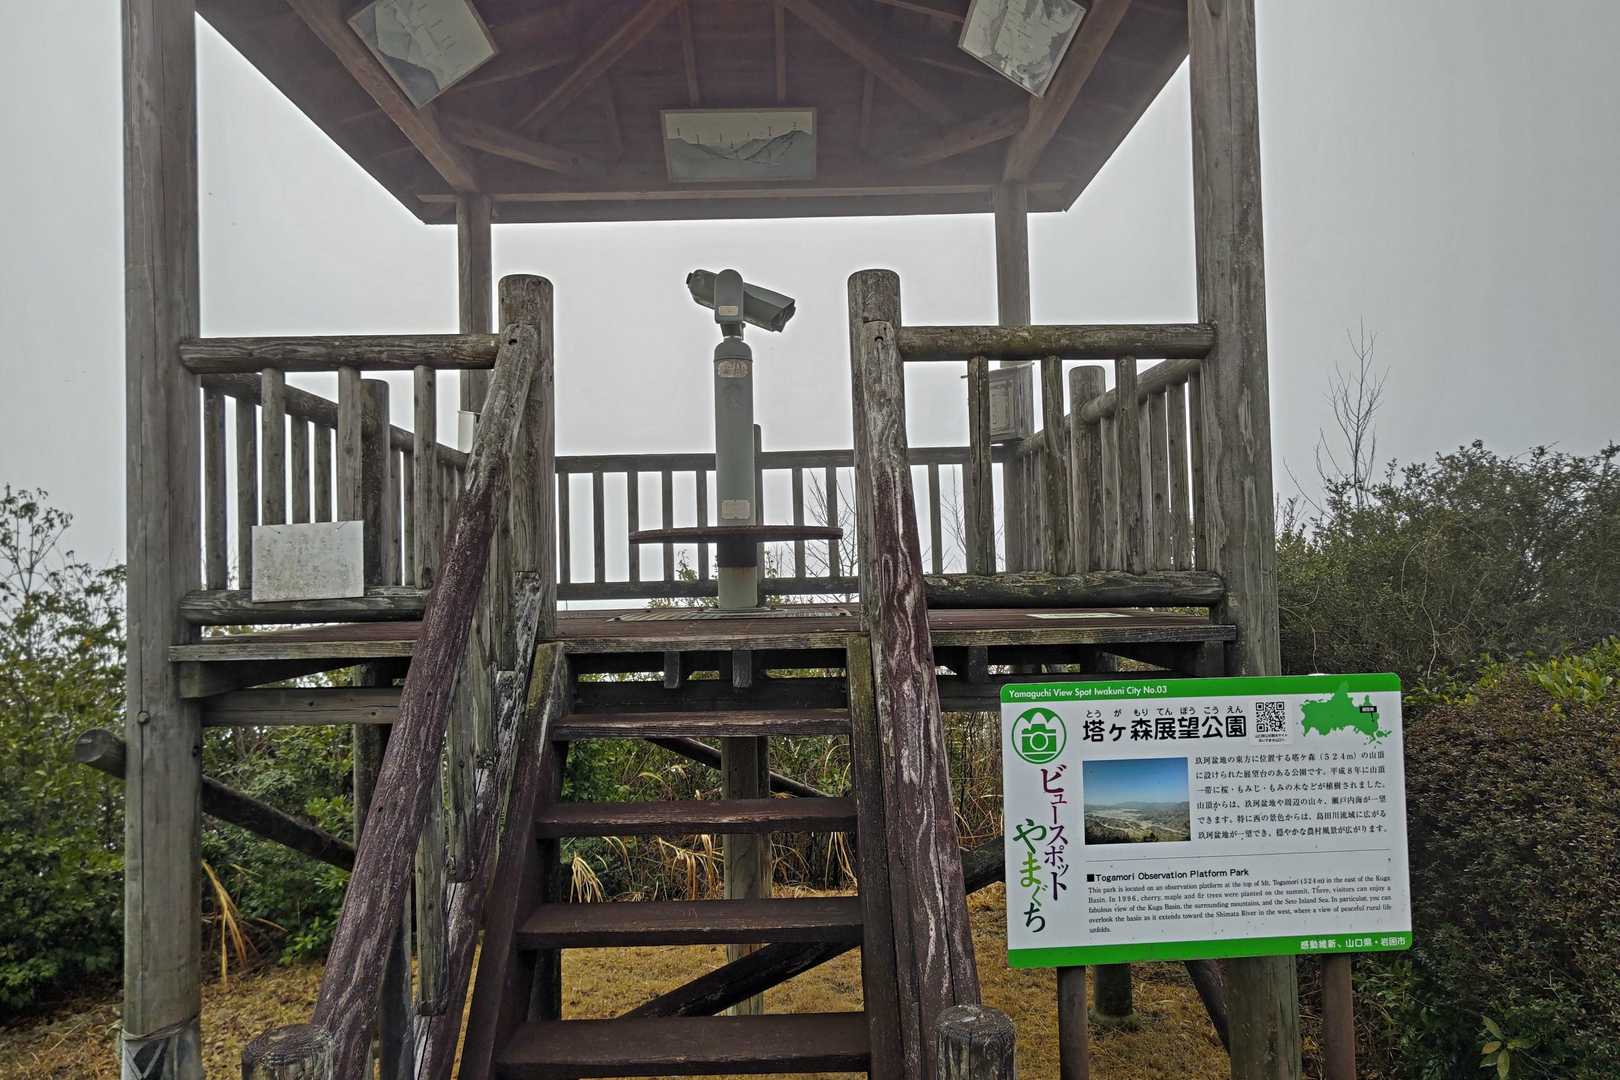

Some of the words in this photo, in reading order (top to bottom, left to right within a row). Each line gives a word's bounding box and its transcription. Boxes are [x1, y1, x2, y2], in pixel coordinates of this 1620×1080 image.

[1008, 688, 1052, 700] Yamaguchi
[1053, 688, 1073, 697] View
[1075, 687, 1092, 698] Spot
[1094, 686, 1124, 696] Iwakuni
[1126, 686, 1141, 696] City
[1143, 685, 1167, 694] No.03
[1086, 709, 1102, 718] とう
[1113, 708, 1122, 718] が
[1134, 708, 1148, 717] もり
[1156, 707, 1173, 715] てん
[1203, 706, 1219, 714] こう
[1227, 705, 1243, 714] えん
[1040, 764, 1069, 901] ビュースポット
[1012, 818, 1048, 933] やまぐち
[1096, 873, 1135, 883] Togamori
[1137, 871, 1188, 881] Observation
[1189, 869, 1228, 878] Platform
[1229, 868, 1249, 877] Park
[1103, 886, 1115, 894] park
[1199, 881, 1223, 890] platform
[1272, 878, 1298, 887] Togamori
[1164, 893, 1181, 902] maple
[1240, 890, 1262, 898] planted
[1194, 901, 1229, 910] surrounding
[1340, 905, 1364, 913] peaceful
